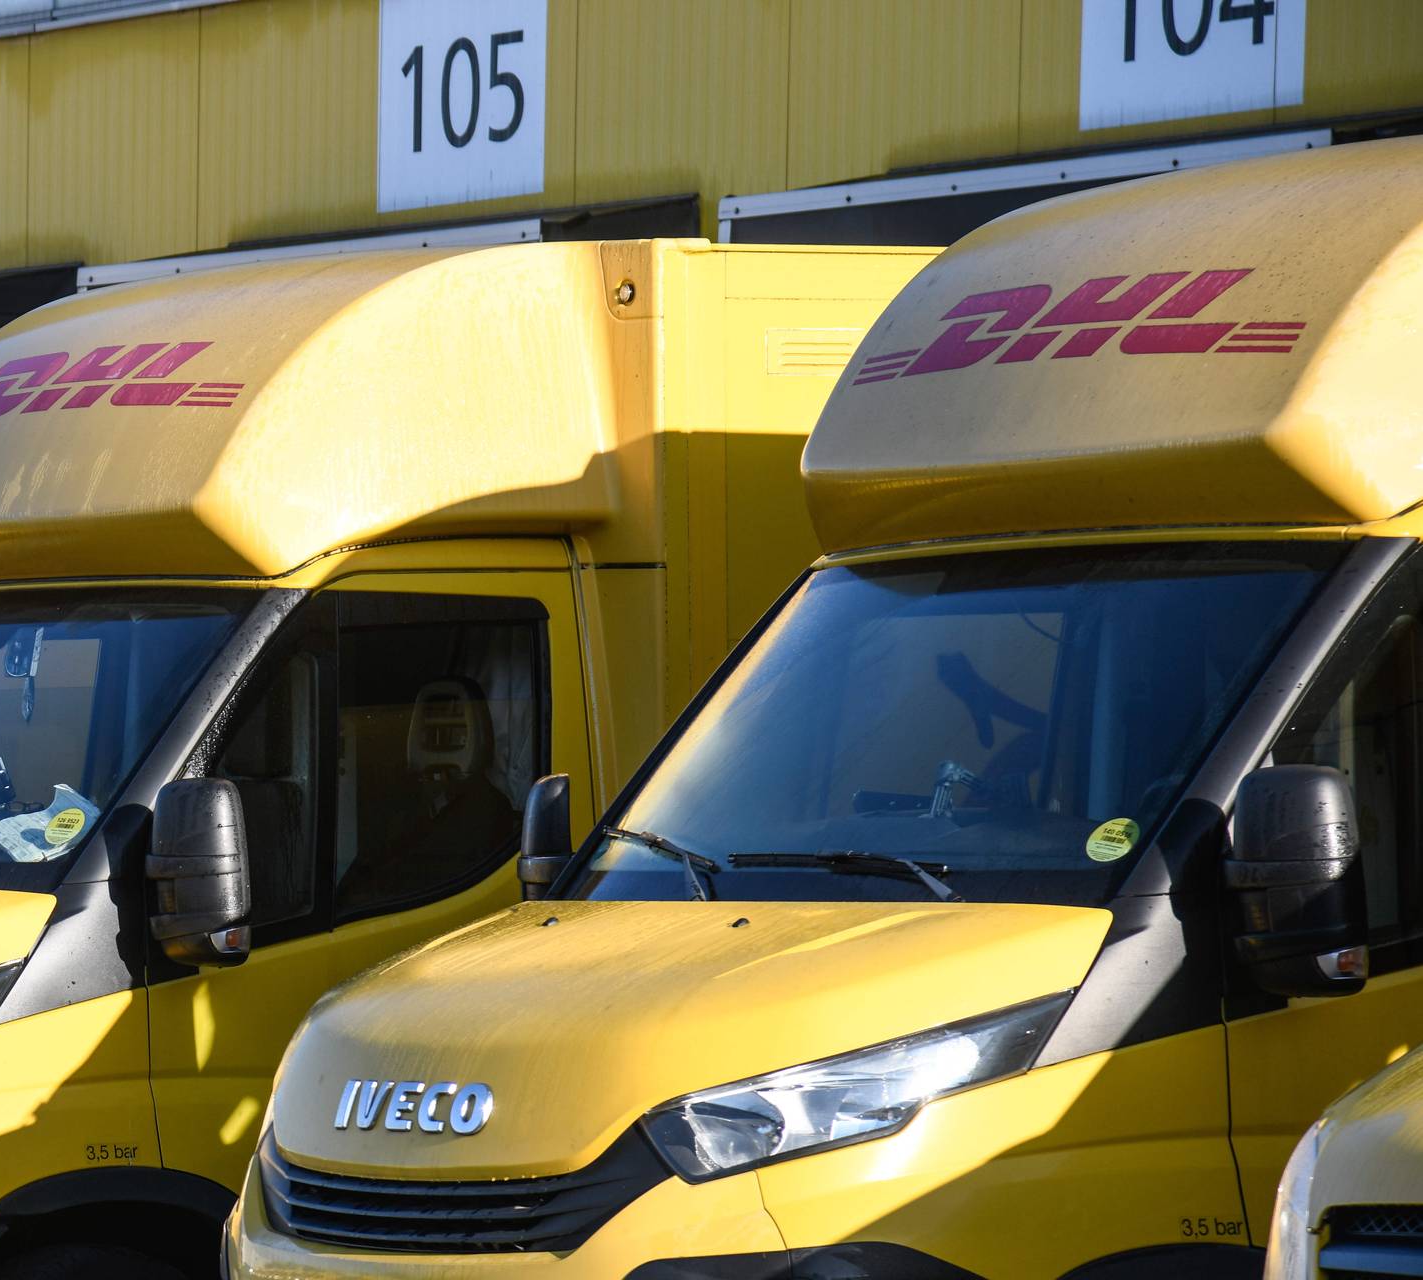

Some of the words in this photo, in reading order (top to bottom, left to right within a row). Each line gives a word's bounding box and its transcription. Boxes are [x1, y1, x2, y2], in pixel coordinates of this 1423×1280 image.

[401, 29, 524, 152] 105
[899, 268, 1255, 377] DHL
[334, 1079, 494, 1136] IVECO
[86, 1145, 109, 1161] 3,5
[114, 1144, 137, 1159] bar
[1181, 1218, 1209, 1238] 3,5
[1214, 1217, 1243, 1236] bar
